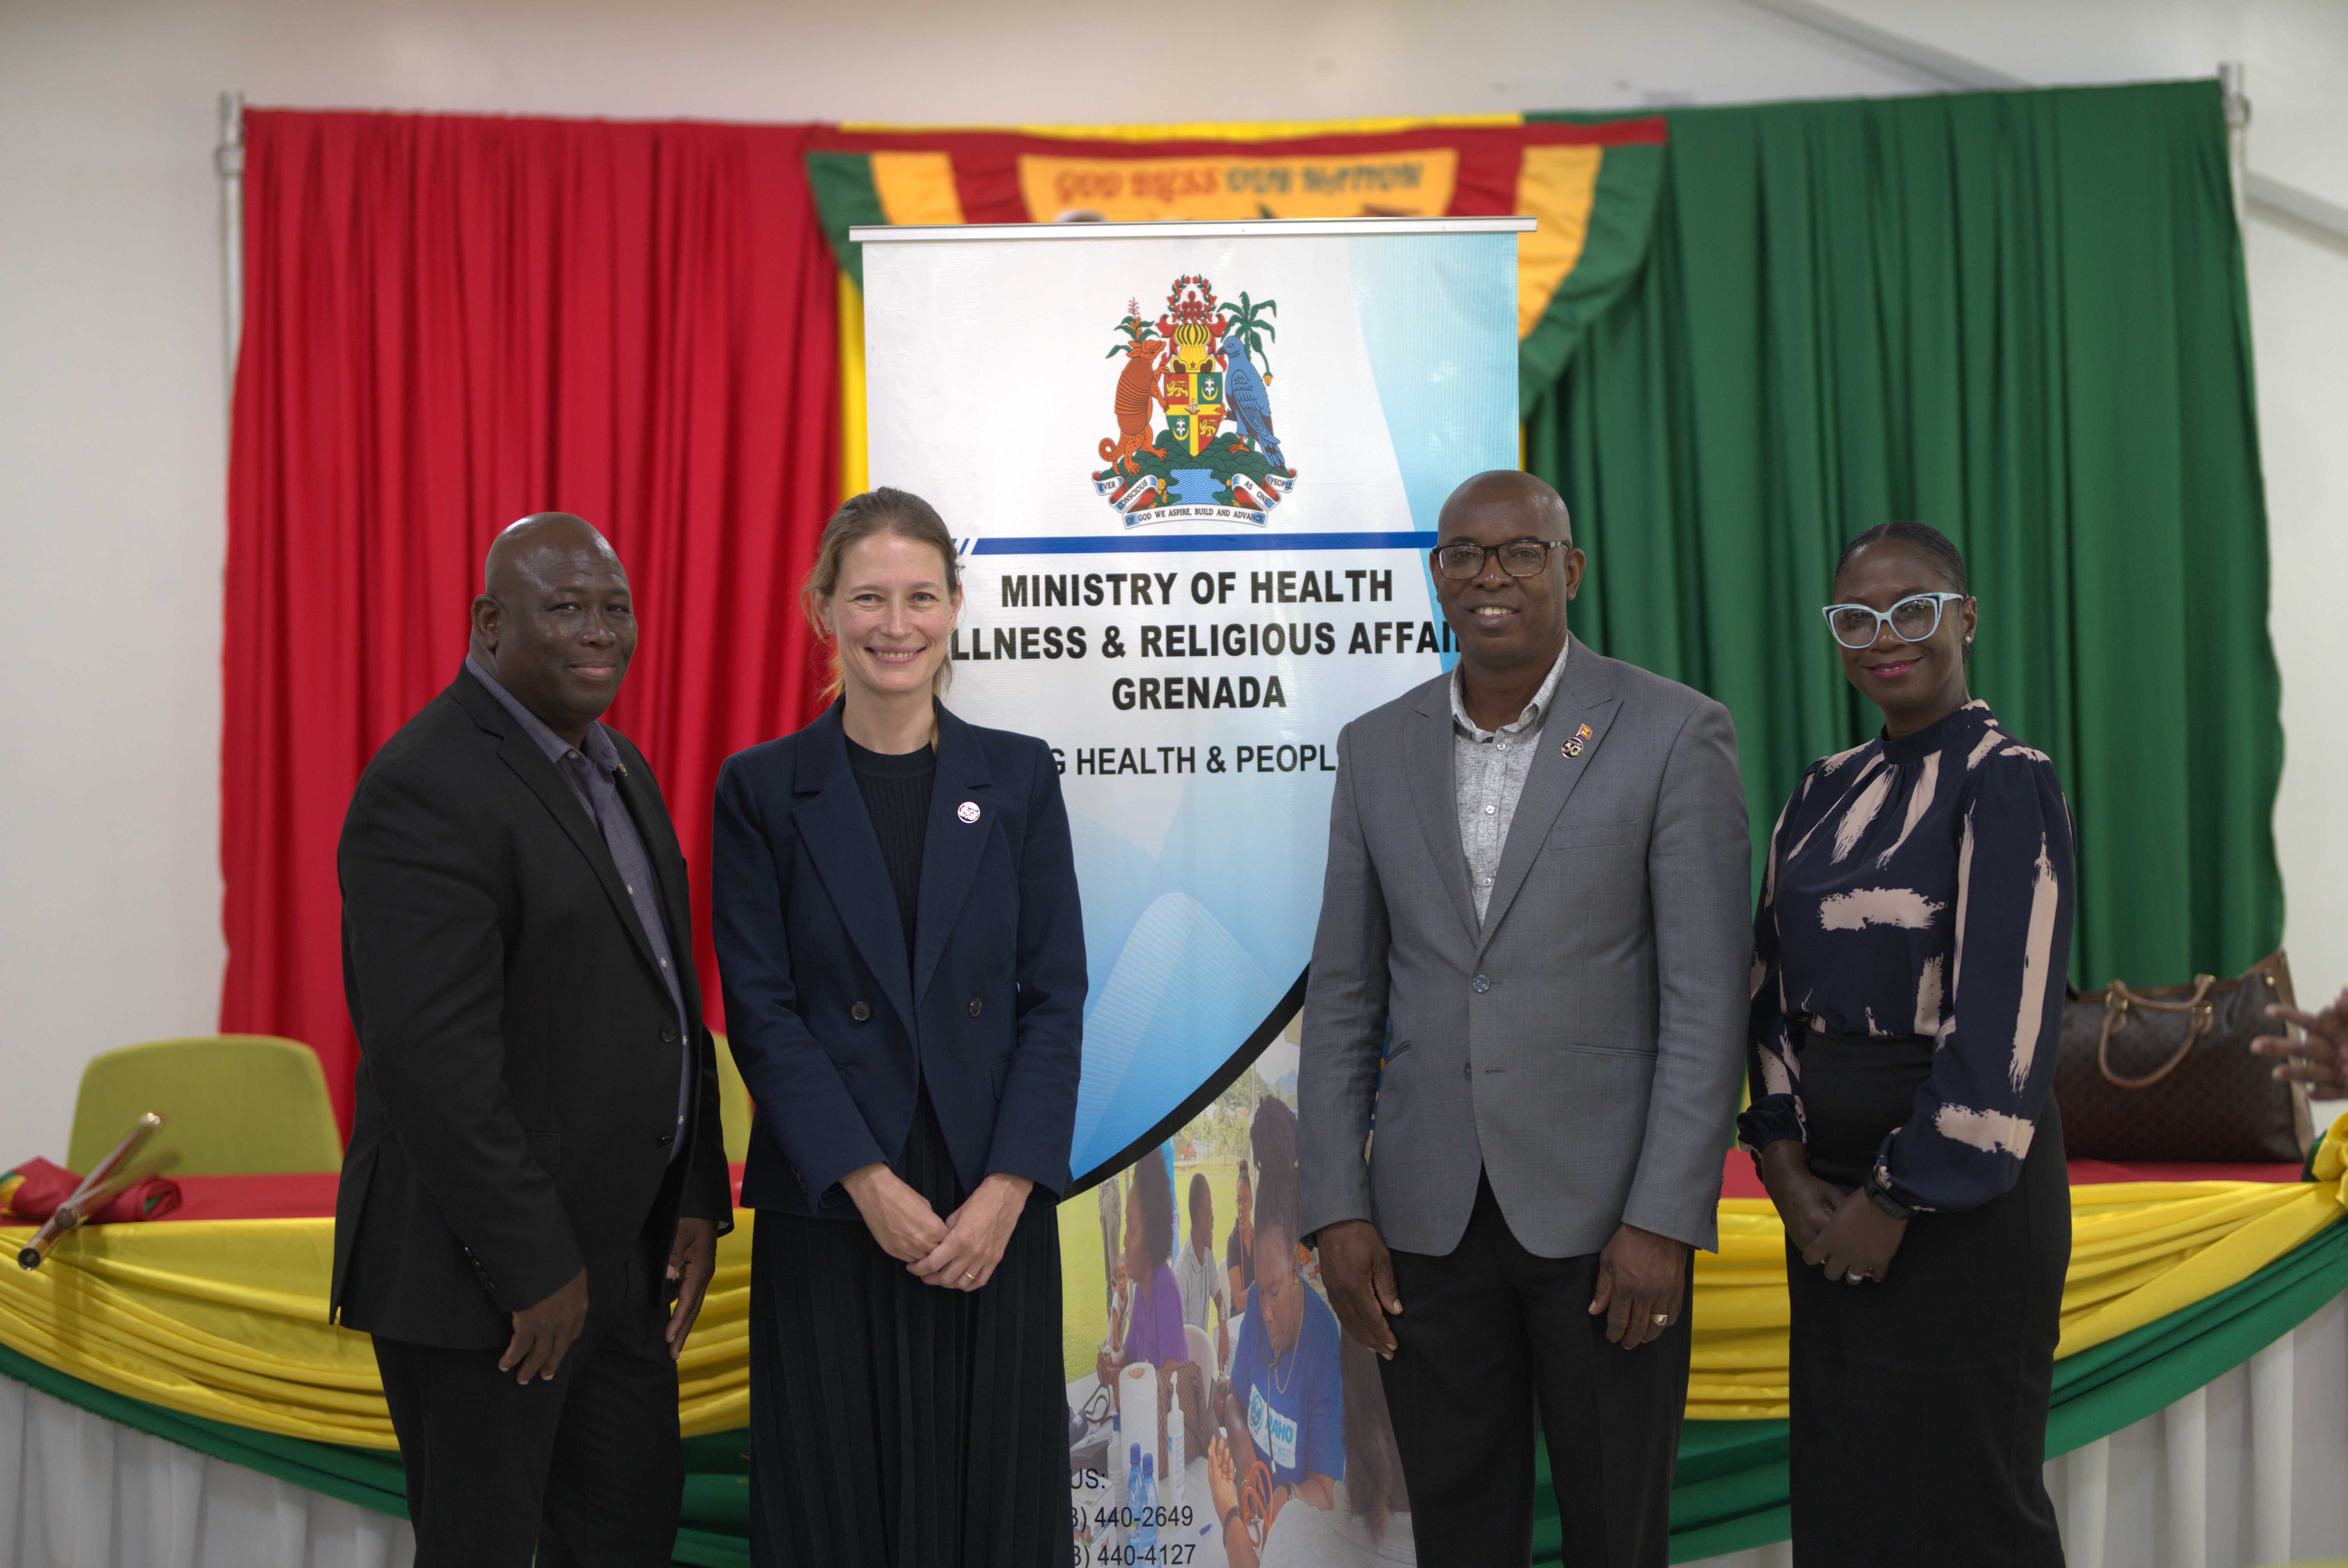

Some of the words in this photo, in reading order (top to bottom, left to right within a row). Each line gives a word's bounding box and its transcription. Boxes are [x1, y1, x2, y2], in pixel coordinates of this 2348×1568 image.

[1100, 481, 1116, 491] EVER
[1117, 479, 1148, 509] CONSCIOUS
[1244, 480, 1253, 490] AS
[1256, 491, 1269, 505] ONE
[1270, 478, 1293, 489] PEOPLE
[1126, 516, 1135, 524] OF
[1138, 512, 1152, 521] GOD
[1168, 508, 1192, 516] ASPIRE,
[1216, 509, 1231, 517] AND
[1233, 510, 1263, 523] ADVANCE
[1002, 573, 1178, 607] MINISTRY
[1191, 572, 1236, 605] OF
[1251, 570, 1392, 604] HEALTH
[951, 625, 1087, 660] LLNESS
[1102, 625, 1126, 659] &
[1141, 622, 1335, 657] RELIGIOUS
[1348, 621, 1461, 654] AFFAI
[1112, 676, 1286, 711] GRENADA
[1077, 746, 1195, 775] HEALTH
[1206, 745, 1227, 773] &
[1237, 744, 1340, 773] PEOPL
[1071, 1467, 1105, 1489] US:
[1094, 1505, 1193, 1528] 440-2649
[1097, 1544, 1196, 1566] 440-4127
